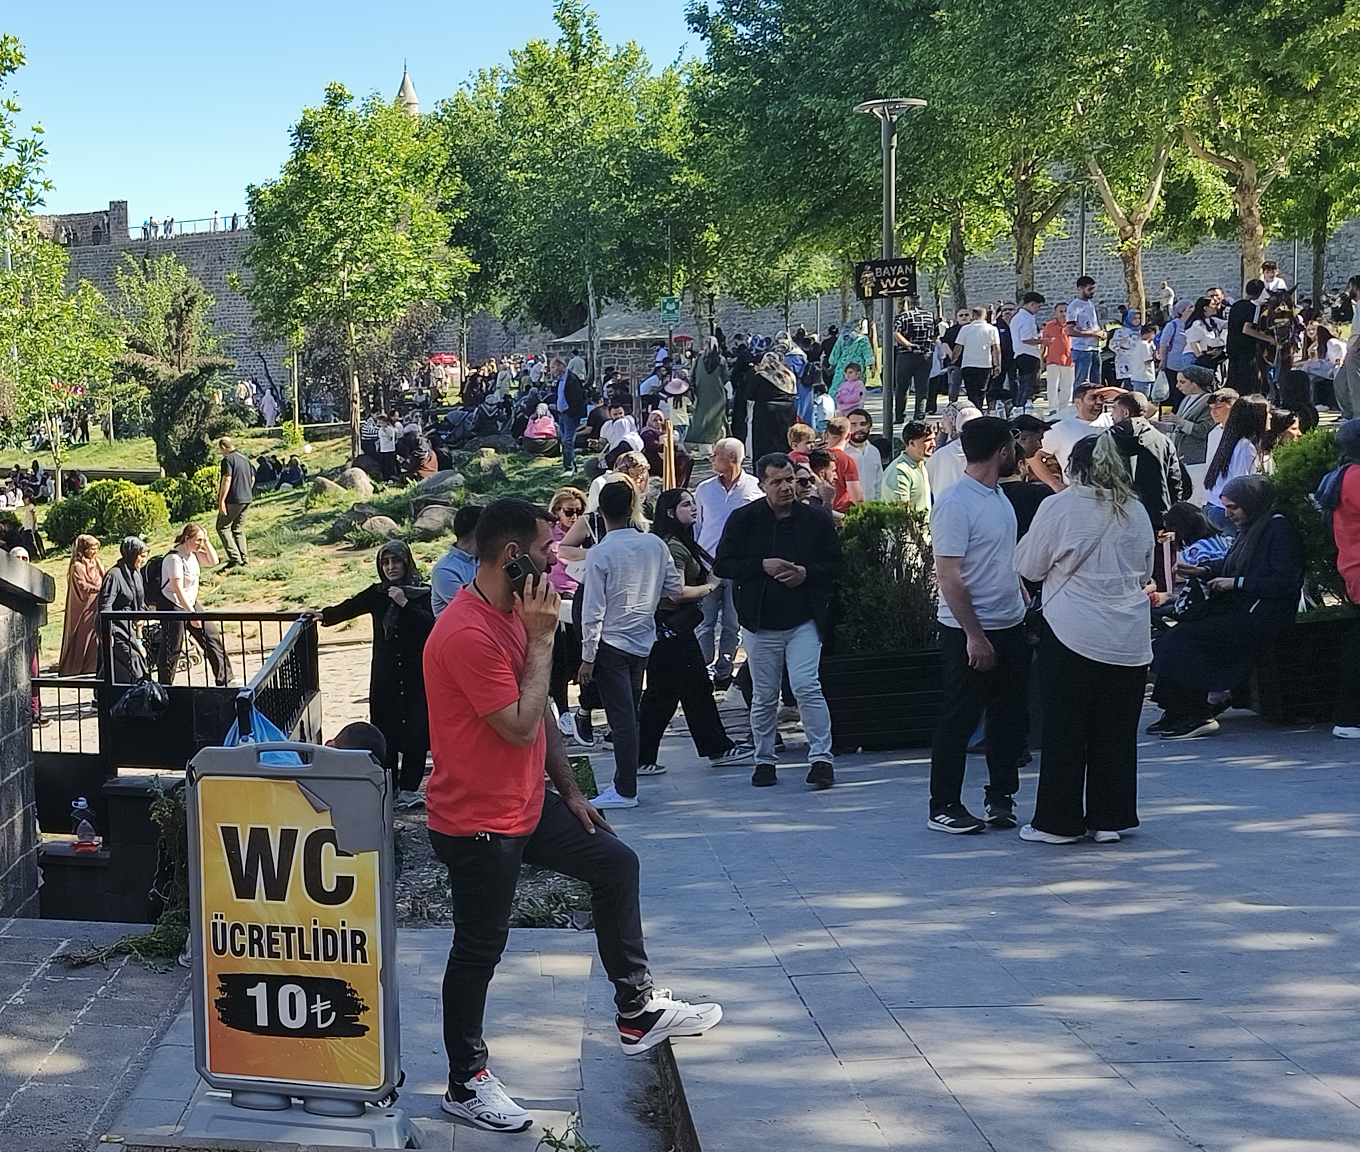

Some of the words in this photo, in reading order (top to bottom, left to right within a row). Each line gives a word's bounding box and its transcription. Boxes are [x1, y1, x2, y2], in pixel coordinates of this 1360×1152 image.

[875, 264, 913, 277] BAYAN
[880, 277, 909, 288] WC
[220, 825, 355, 905] WC
[211, 913, 368, 964] ÜCRETLİDİR
